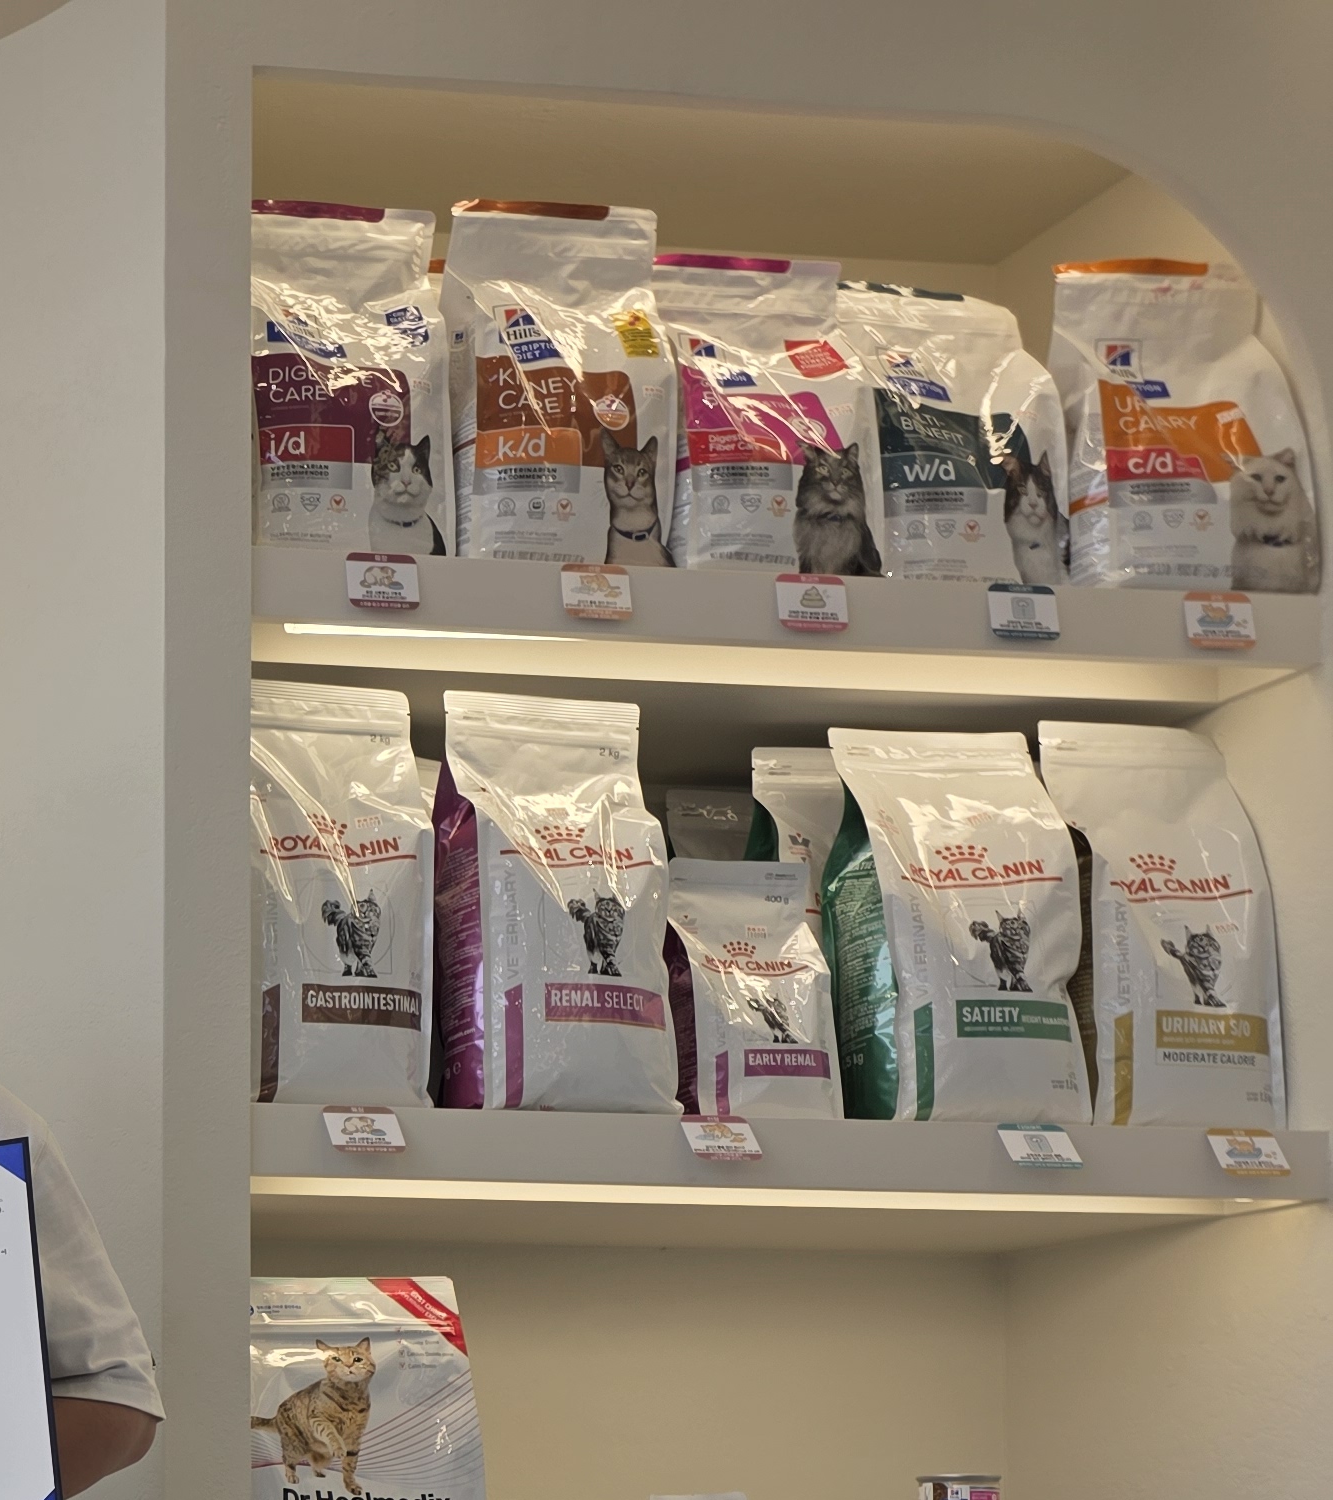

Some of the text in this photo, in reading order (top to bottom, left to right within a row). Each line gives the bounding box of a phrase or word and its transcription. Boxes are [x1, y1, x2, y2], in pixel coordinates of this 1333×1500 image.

[269, 385, 328, 403] CARE
[497, 432, 547, 459] k/d
[903, 458, 957, 483] w/d
[1127, 451, 1175, 475] c/d
[599, 747, 620, 760] 2 kg
[269, 834, 323, 853] ROYA
[910, 859, 1045, 884] ROYAL CANIN
[1164, 874, 1230, 894] CANIN
[764, 895, 782, 904] 400
[307, 989, 420, 1016] GASTROINTESTINAL
[550, 988, 645, 1012] RENAL SELECT
[962, 1005, 1020, 1024] SATIETY
[1161, 1015, 1227, 1036] URINARY
[748, 1053, 817, 1067] EARLY RENAL
[1162, 1050, 1257, 1067] MODERATE CALORIE
